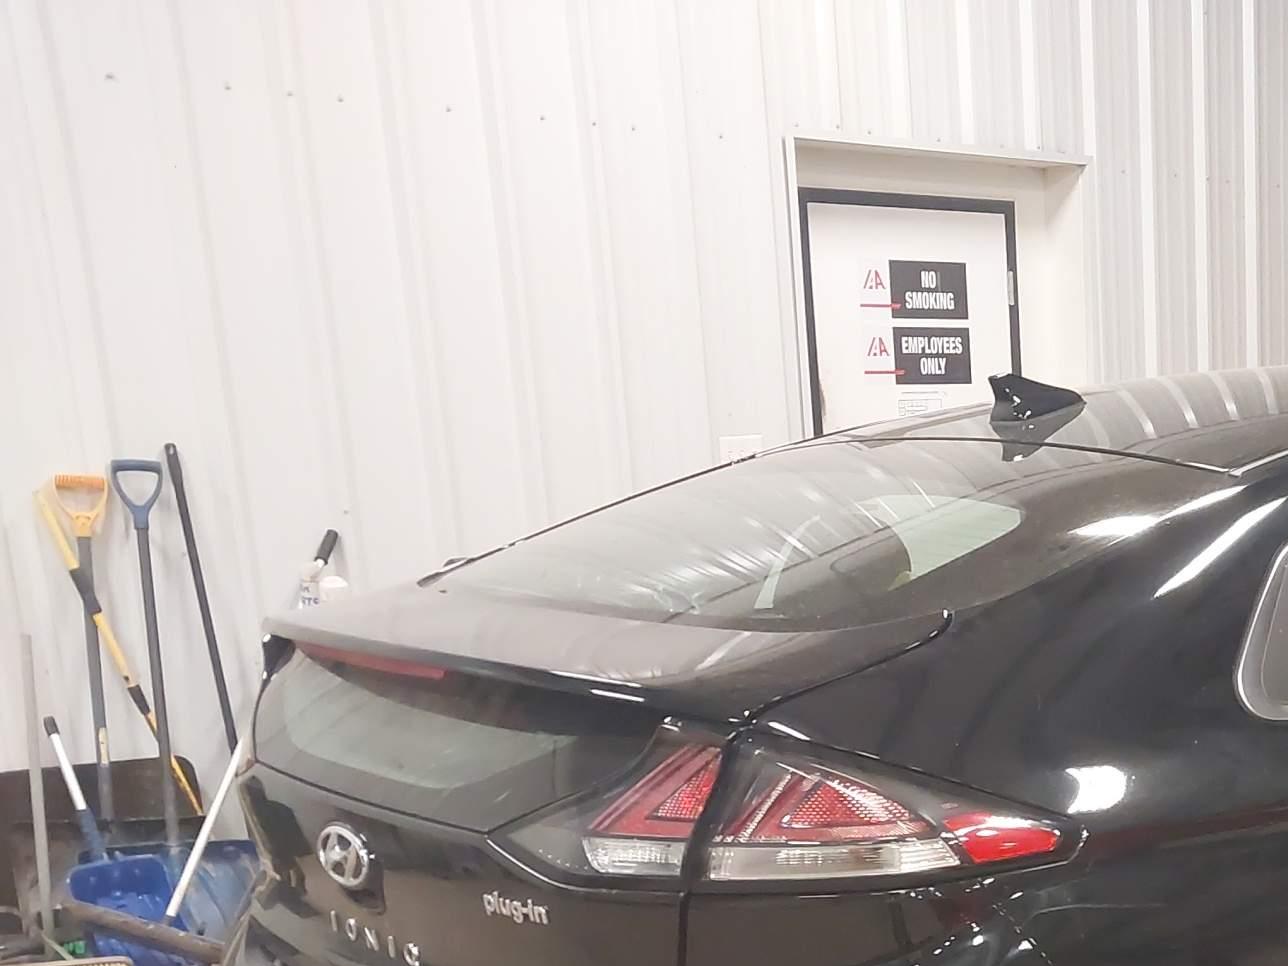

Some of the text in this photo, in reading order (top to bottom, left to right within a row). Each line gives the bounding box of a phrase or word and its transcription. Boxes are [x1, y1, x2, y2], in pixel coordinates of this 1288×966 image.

[920, 270, 937, 288] NO
[905, 291, 955, 310] SMOKING
[901, 336, 963, 354] EMPLOYEES
[920, 357, 947, 375] ONLY
[482, 890, 549, 925] plug-in
